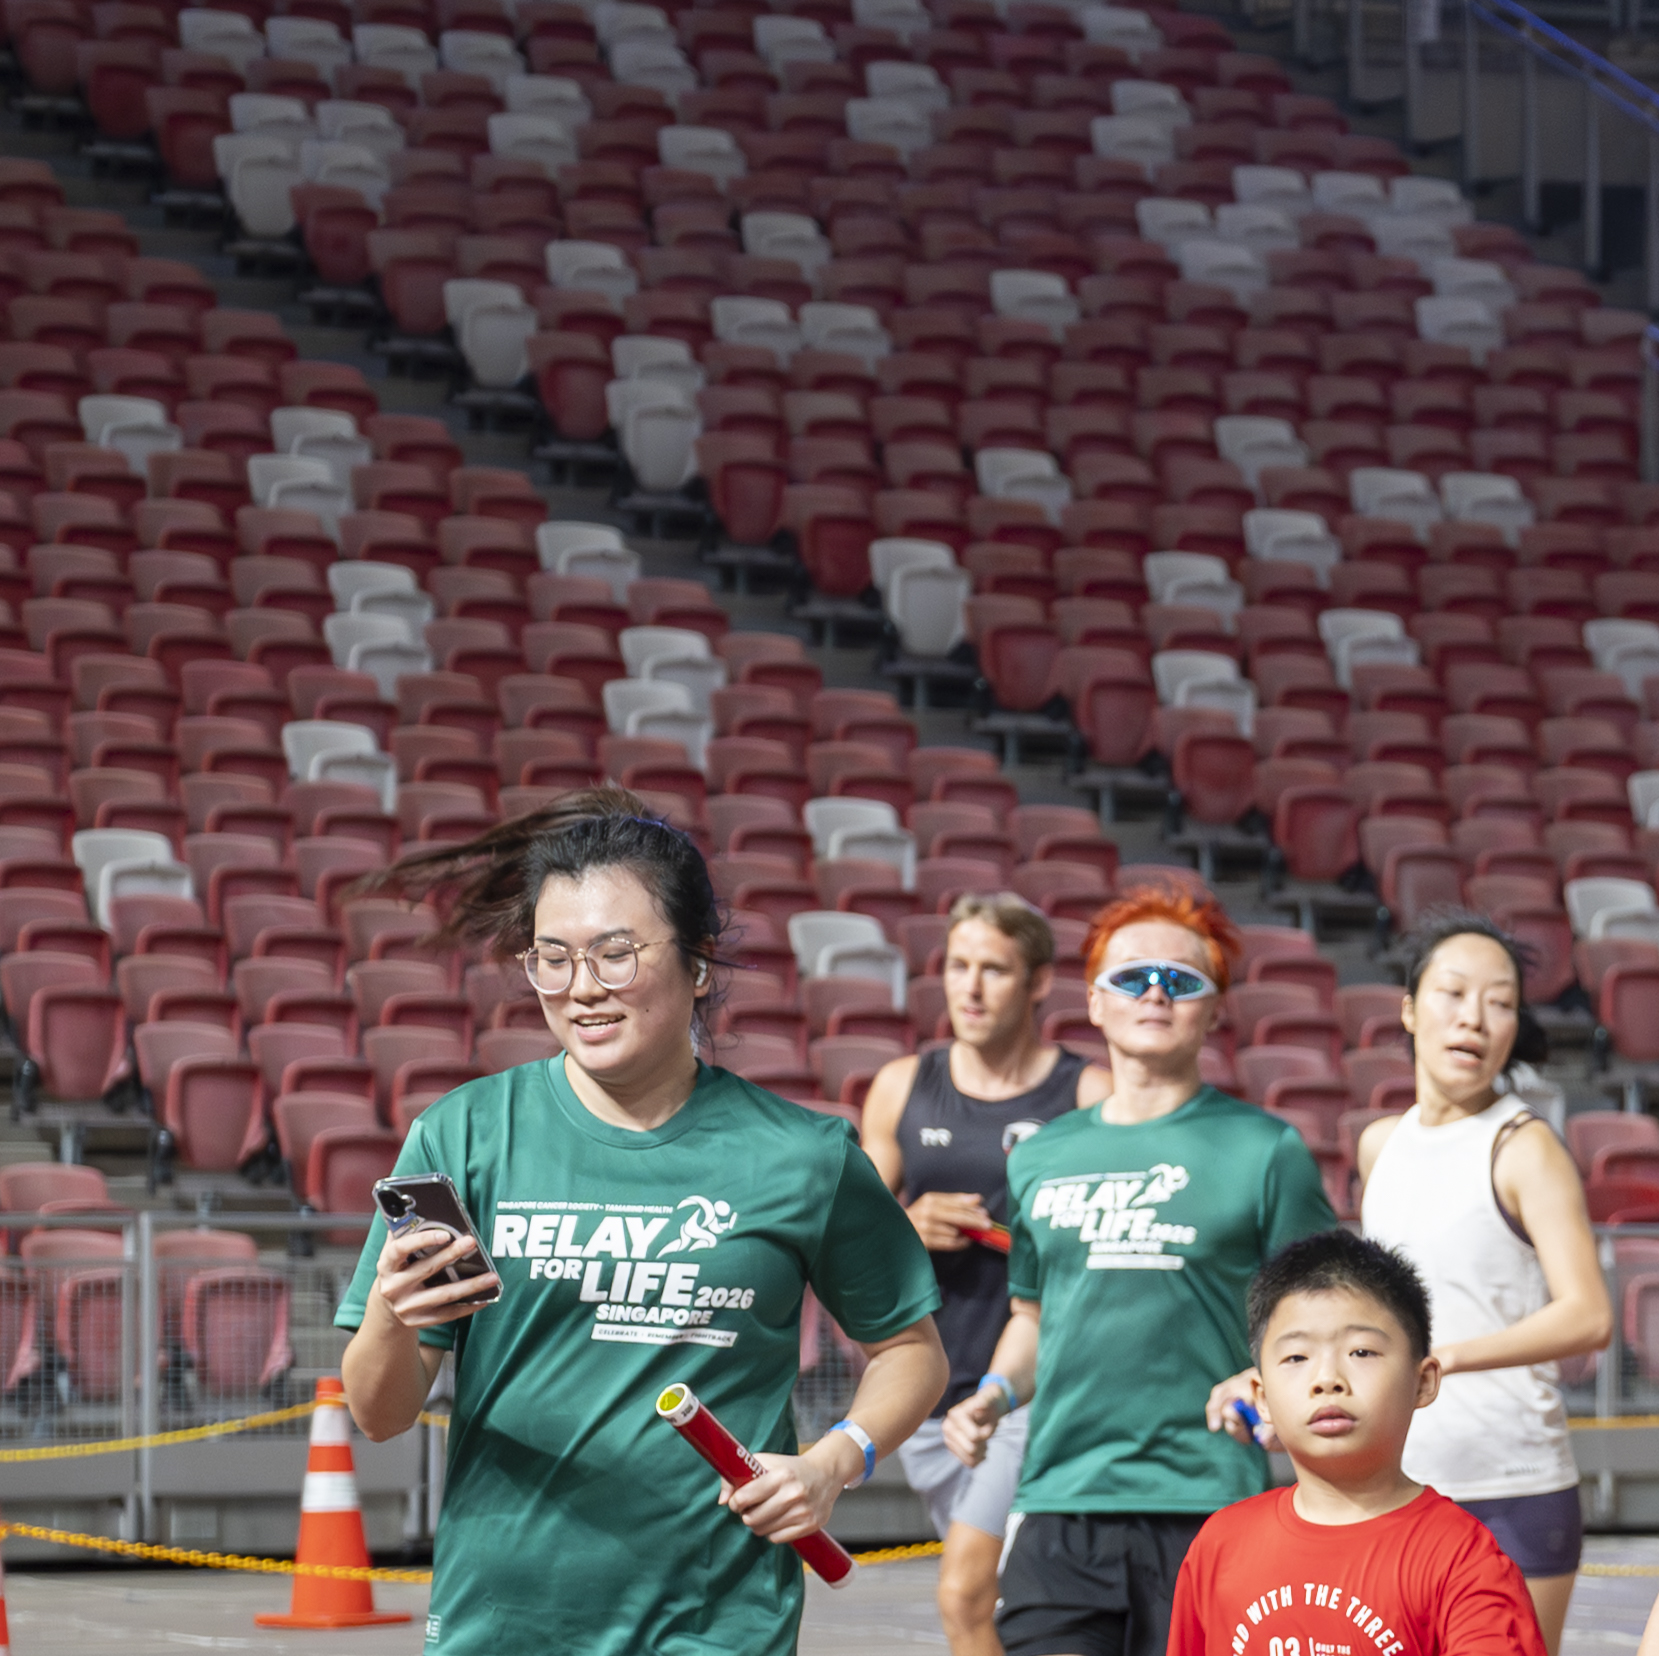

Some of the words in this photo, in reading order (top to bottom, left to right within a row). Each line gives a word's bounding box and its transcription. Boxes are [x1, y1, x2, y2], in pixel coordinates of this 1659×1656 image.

[1031, 1179, 1145, 1221] RELAY
[491, 1213, 671, 1260] RELAY
[1079, 1208, 1157, 1243] LIFE
[529, 1258, 584, 1280] FOR
[579, 1260, 701, 1307] LIFE
[693, 1285, 756, 1310] 2026
[595, 1303, 714, 1326] SINGAPORE
[1246, 1584, 1293, 1625] WITH
[1304, 1582, 1342, 1610] THE
